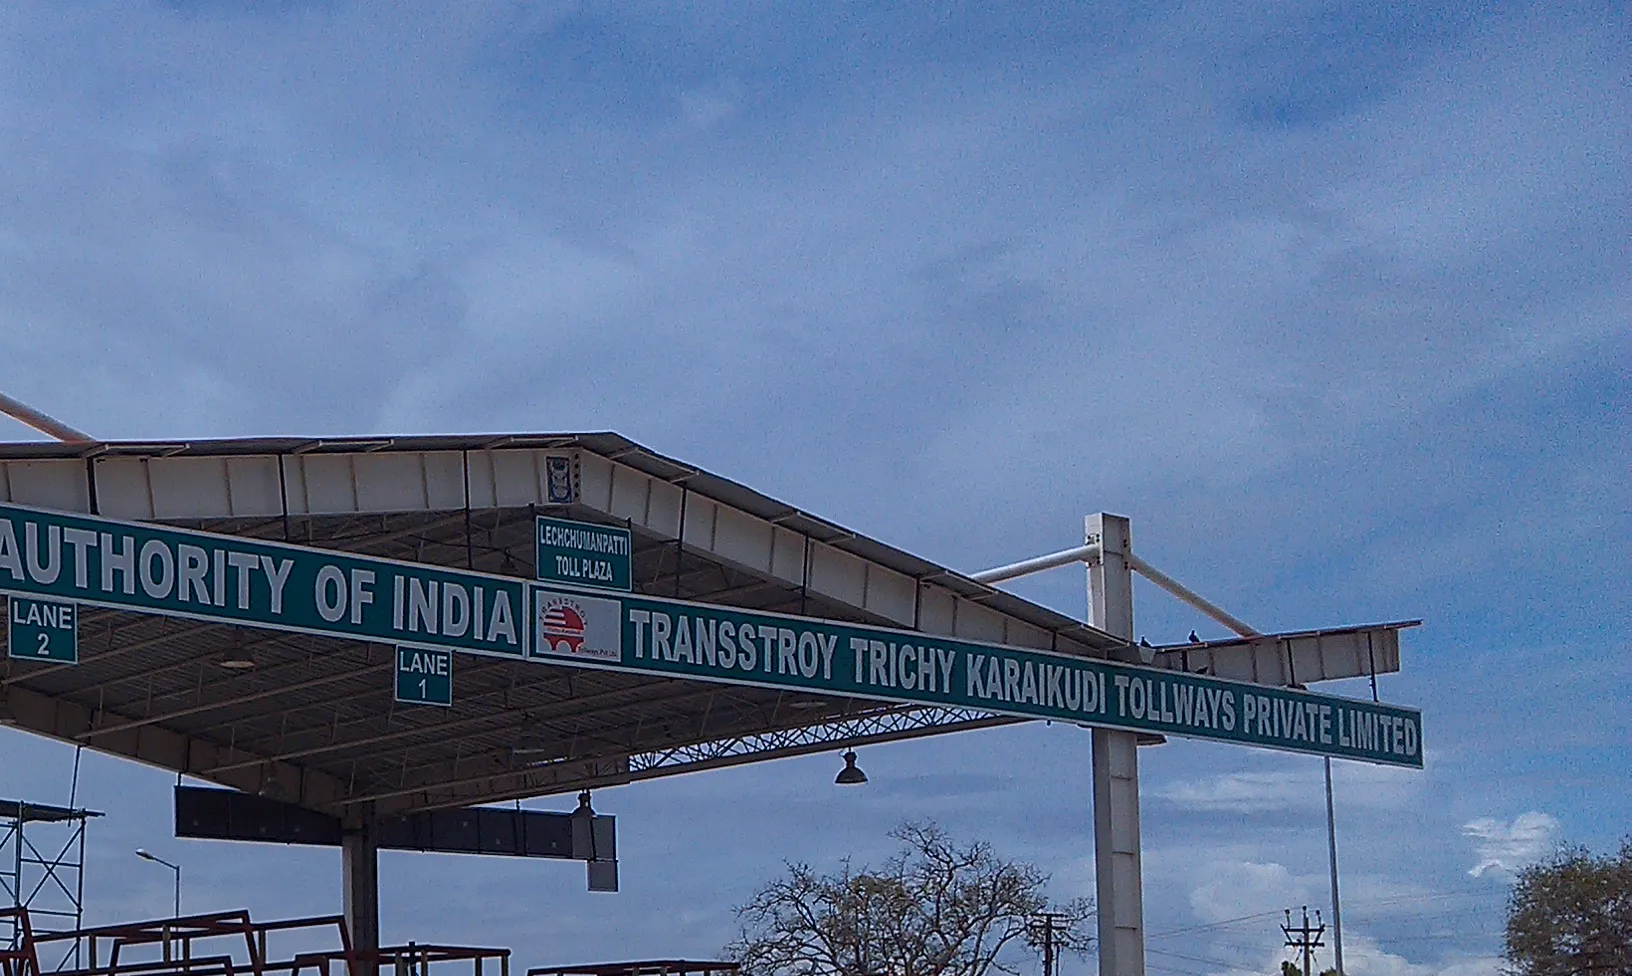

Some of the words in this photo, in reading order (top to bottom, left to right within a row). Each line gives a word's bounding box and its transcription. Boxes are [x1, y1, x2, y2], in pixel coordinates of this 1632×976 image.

[555, 555, 581, 577] TOLL
[582, 558, 613, 581] PLAZA
[13, 601, 72, 630] LANE
[315, 565, 376, 625] OF
[393, 575, 517, 645] INDIA
[37, 632, 50, 656] 2
[399, 650, 448, 677] LANE
[418, 678, 427, 700] 1
[629, 609, 838, 680] TRANSSTROY
[850, 637, 956, 694] TRICHY
[967, 653, 1106, 714] KARAIKUDI
[1114, 675, 1236, 731] TOLLWAYS
[1244, 694, 1332, 745] PRIVATE
[1337, 706, 1417, 757] LIMITED
